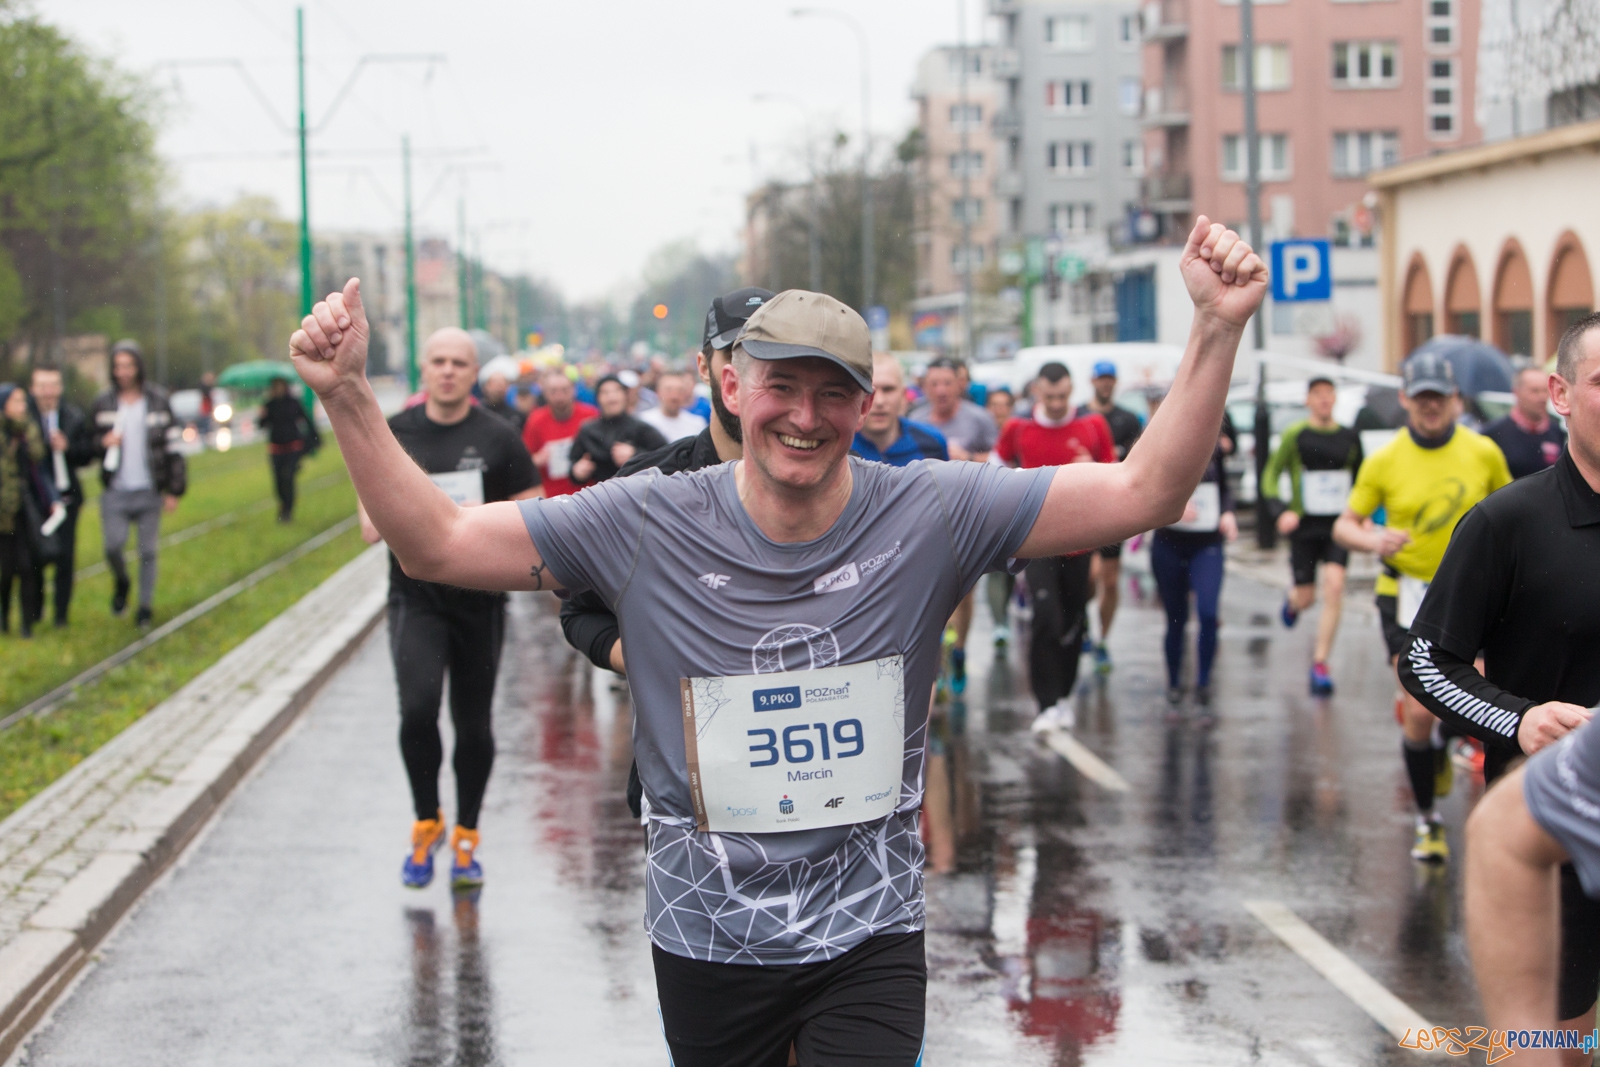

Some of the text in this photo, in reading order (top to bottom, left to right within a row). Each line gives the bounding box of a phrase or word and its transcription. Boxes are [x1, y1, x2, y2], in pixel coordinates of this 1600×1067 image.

[1282, 245, 1321, 297] P
[747, 718, 865, 768] 3619
[787, 768, 833, 783] Marcin
[824, 796, 845, 809] 4F
